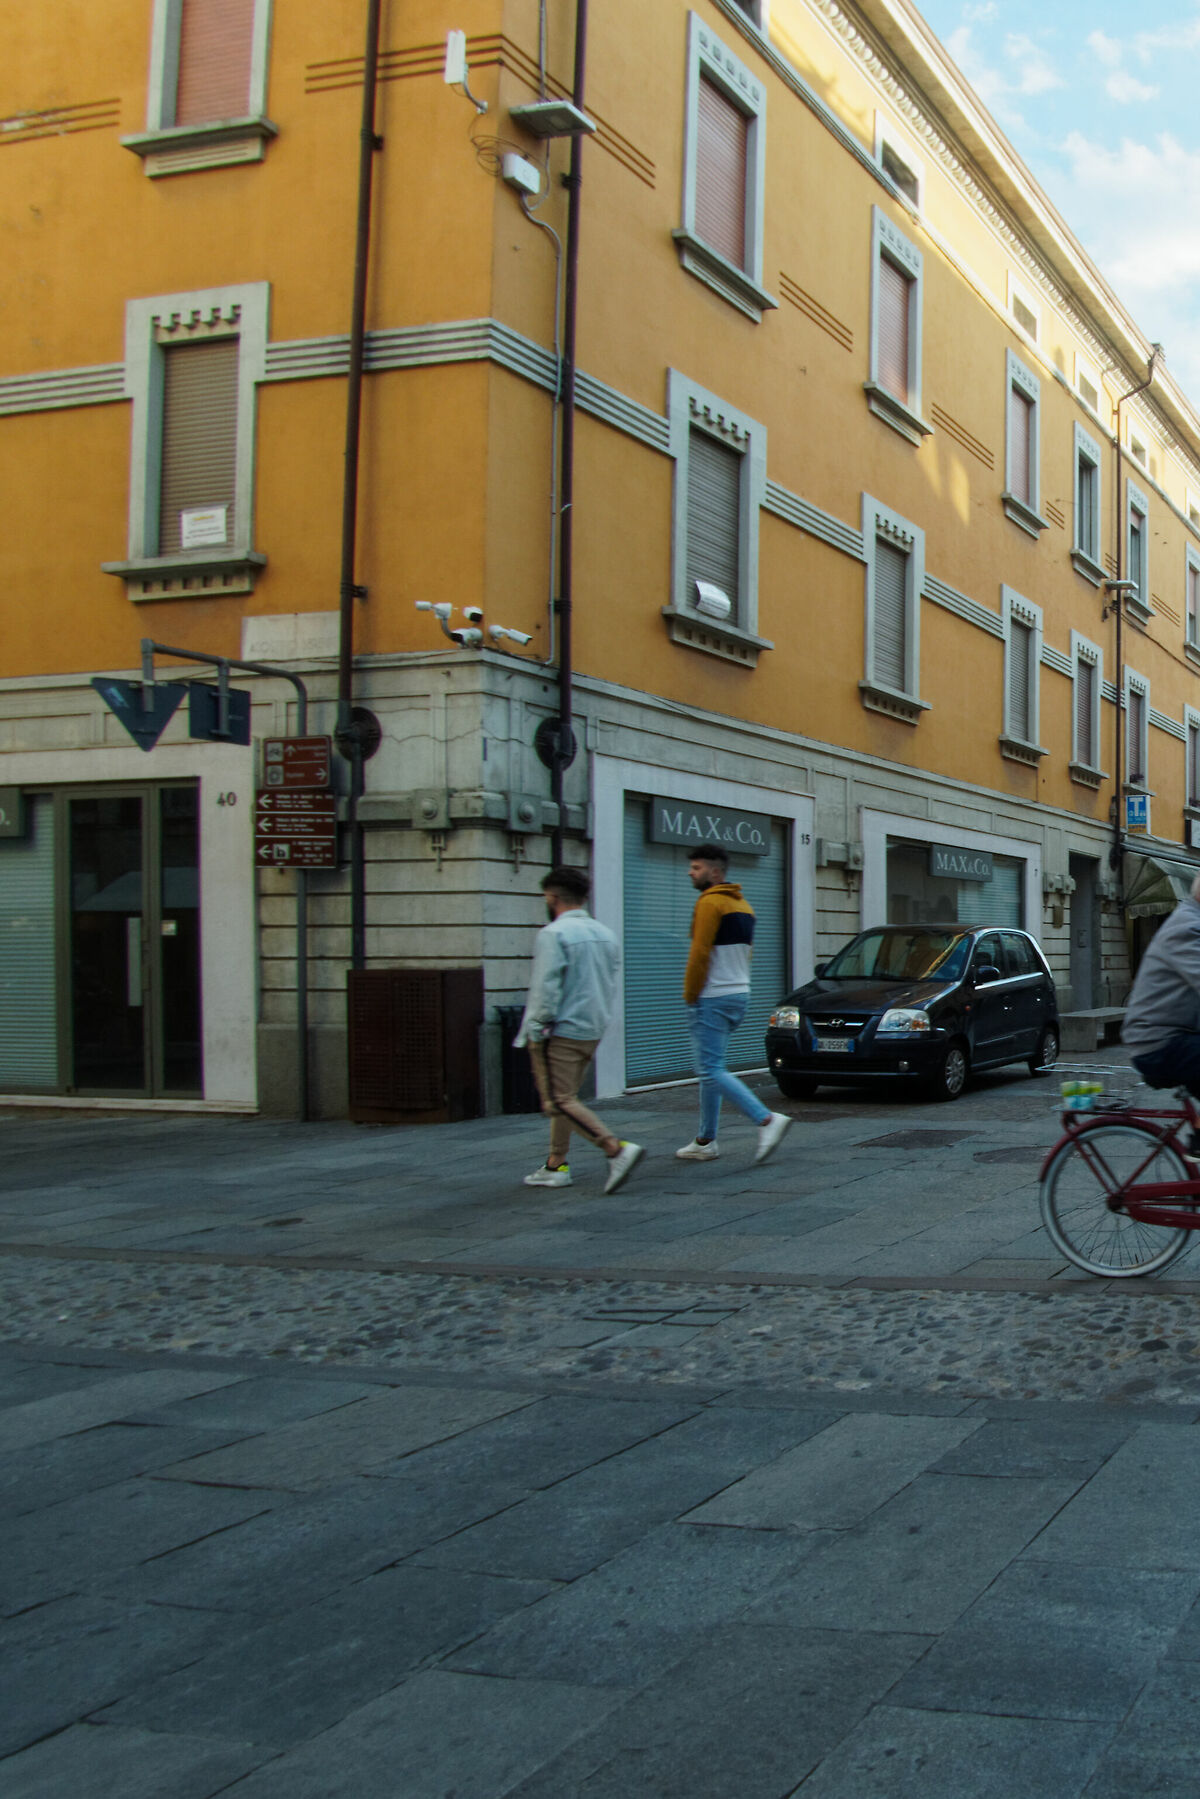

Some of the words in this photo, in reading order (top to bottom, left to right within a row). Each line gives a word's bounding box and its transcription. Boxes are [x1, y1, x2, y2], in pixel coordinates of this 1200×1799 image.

[216, 792, 237, 807] 40
[661, 808, 766, 847] MAX&Co.
[801, 832, 811, 845] 15
